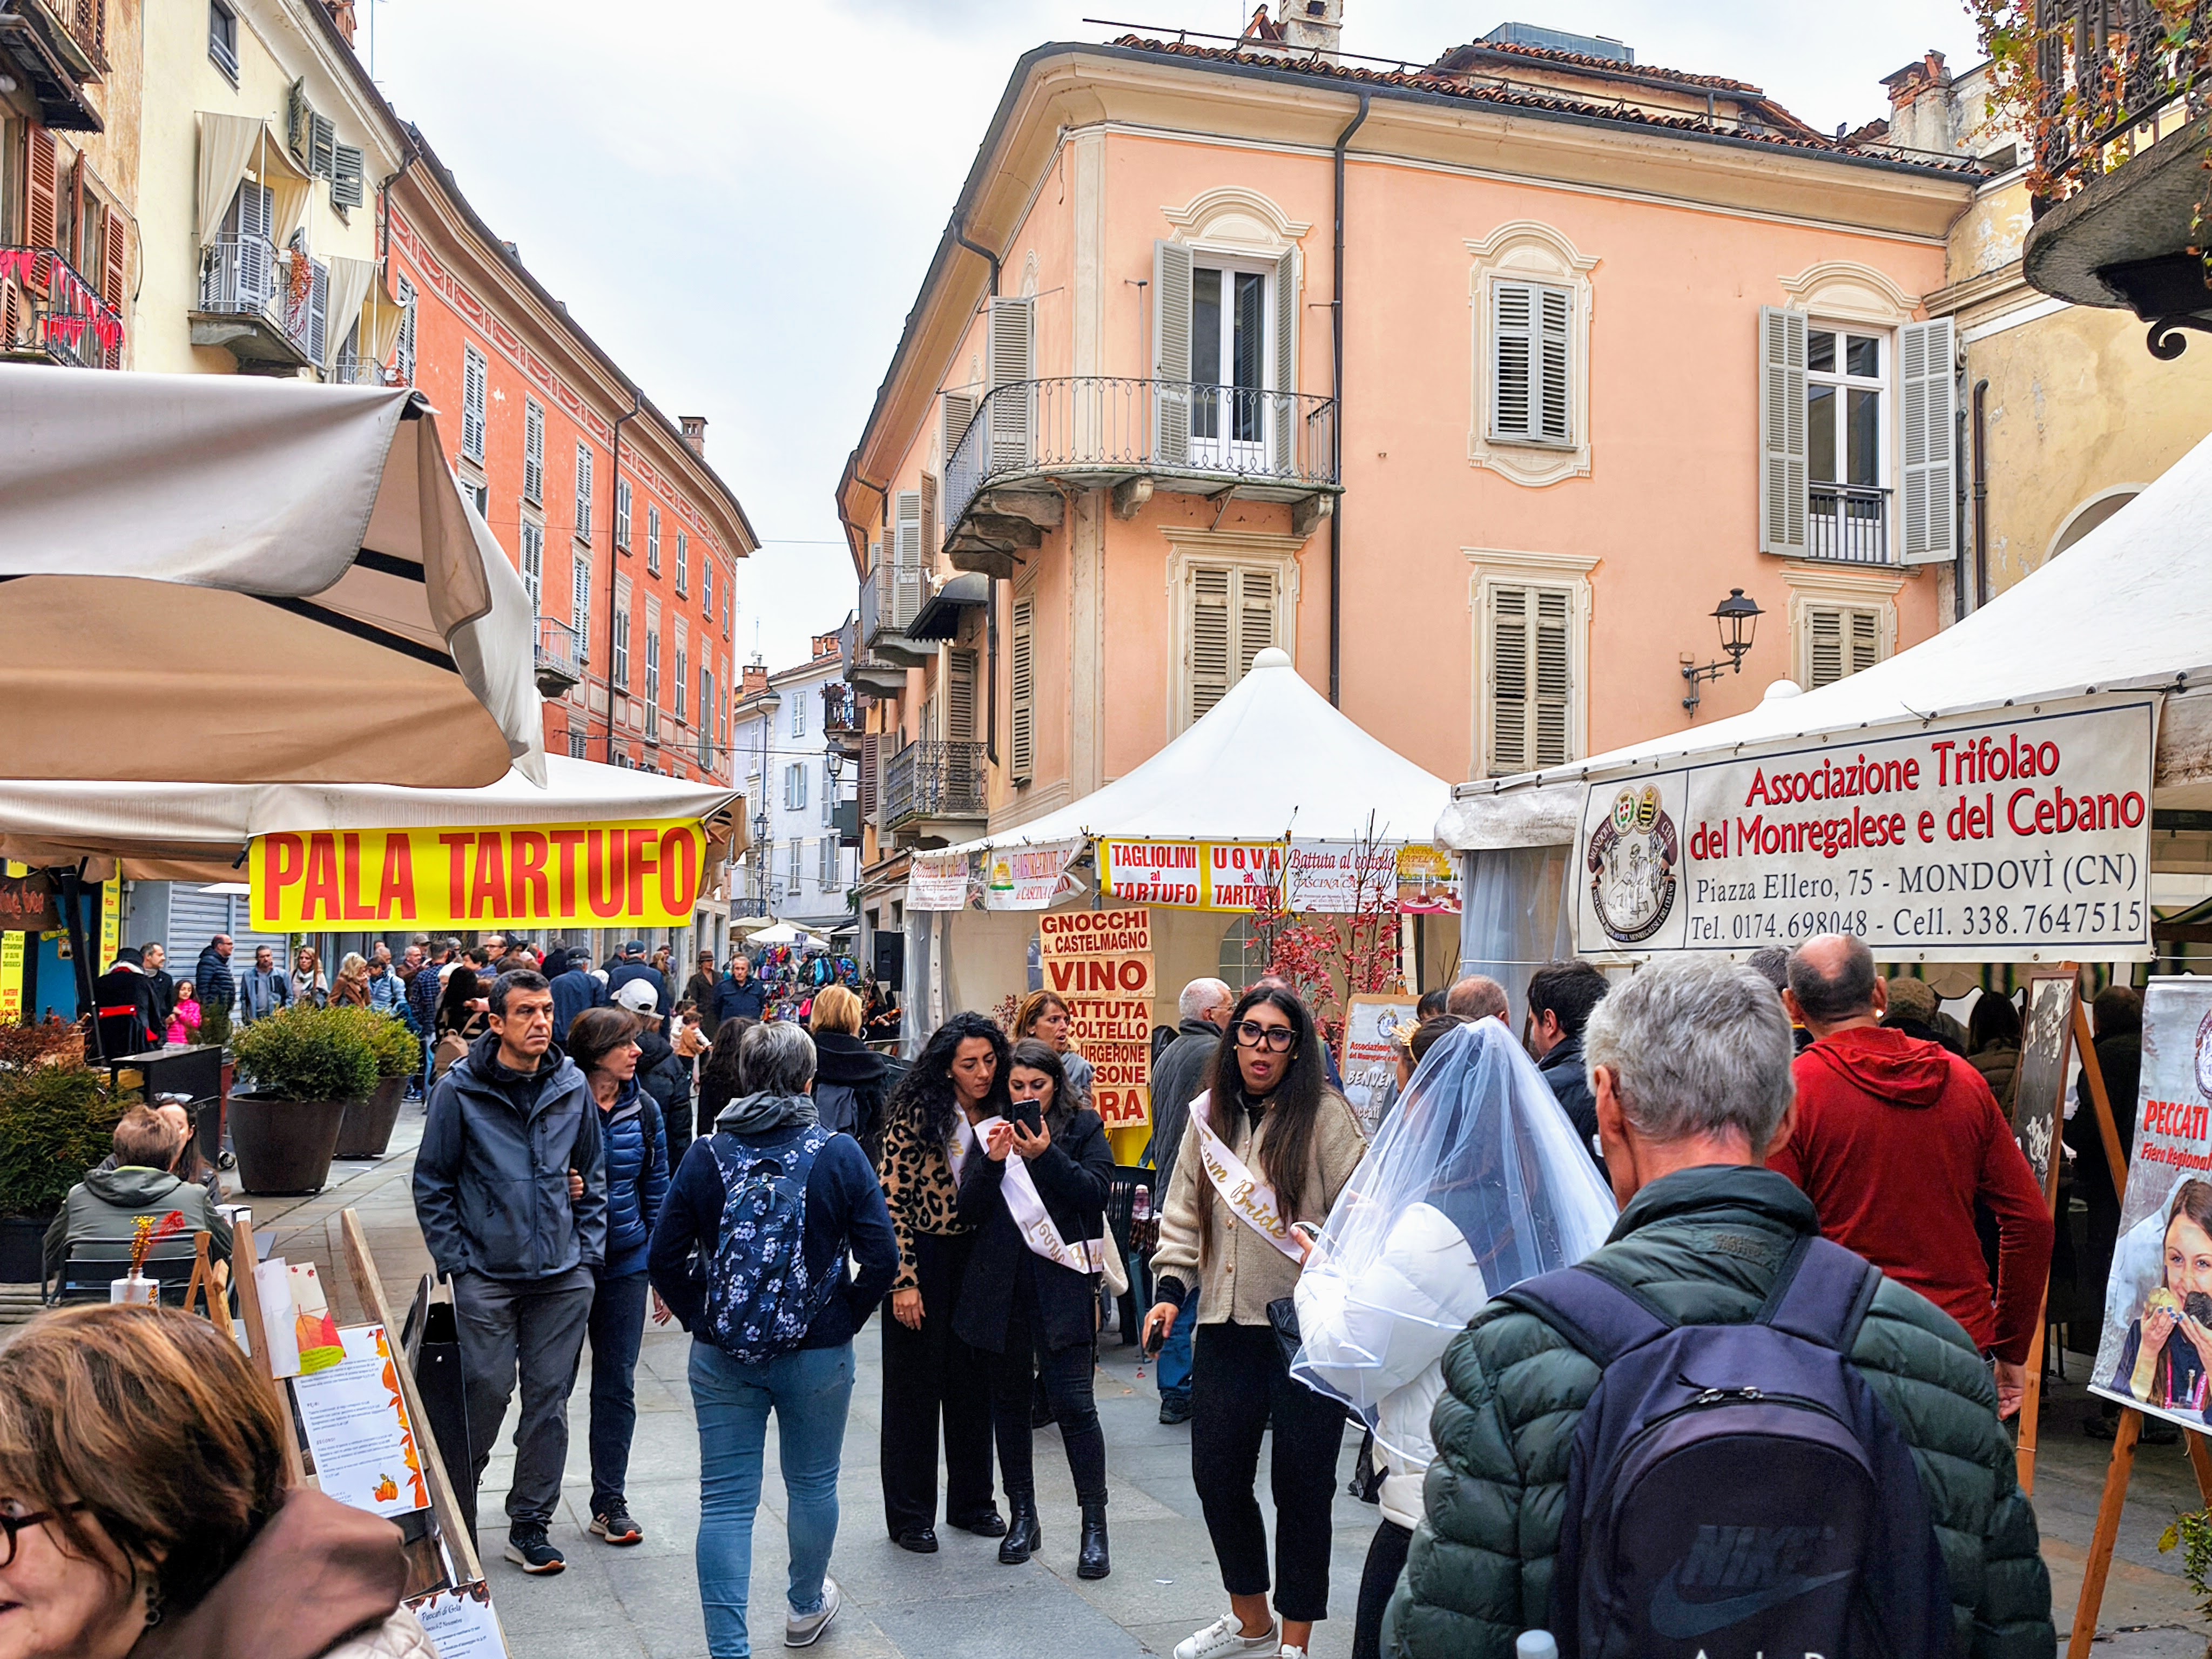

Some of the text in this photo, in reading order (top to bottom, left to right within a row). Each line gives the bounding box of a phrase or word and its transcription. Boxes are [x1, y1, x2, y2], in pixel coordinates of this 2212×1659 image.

[1745, 732, 2060, 807] Associazione Trifolao
[1690, 785, 2145, 860] del Monregalese e del Cebano
[1112, 845, 1197, 868] TAGLIOLINI
[1214, 848, 1280, 870] UOVA
[1290, 848, 1336, 869] Battuta
[1340, 847, 1353, 869] al
[265, 826, 696, 920] PALA TARTUFO
[1150, 870, 1161, 881] al
[1243, 872, 1254, 884] al
[1697, 878, 1756, 903] Piazza
[1763, 873, 1839, 902] Ellero,
[1848, 868, 1873, 896] 75
[1898, 849, 2054, 894] MONDOVÌ
[2063, 853, 2137, 894] (CN)
[1113, 882, 1198, 904] TARTUFO
[1042, 910, 1147, 934] GNOCCHI
[1691, 916, 1725, 940] Tel.
[1893, 907, 1951, 936] Cell.
[1963, 901, 2141, 935] 338.7647515
[1043, 930, 1147, 954] AL CASTELMAGNO
[1049, 960, 1147, 992] VINO
[1068, 1001, 1148, 1019] ATTUTA
[1081, 1043, 1145, 1063] URGERONE
[1351, 1041, 1391, 1052] Associazione
[1095, 1065, 1146, 1083] SONE
[1346, 1070, 1396, 1088] BENVEN
[1092, 1089, 1144, 1121] RA
[2143, 1100, 2209, 1141] PECCATI
[2140, 1142, 2212, 1172] Fiera Regional
[1230, 1179, 1287, 1239] Bride
[1022, 1214, 1065, 1263] Team
[1681, 1524, 1821, 1586] NIKE
